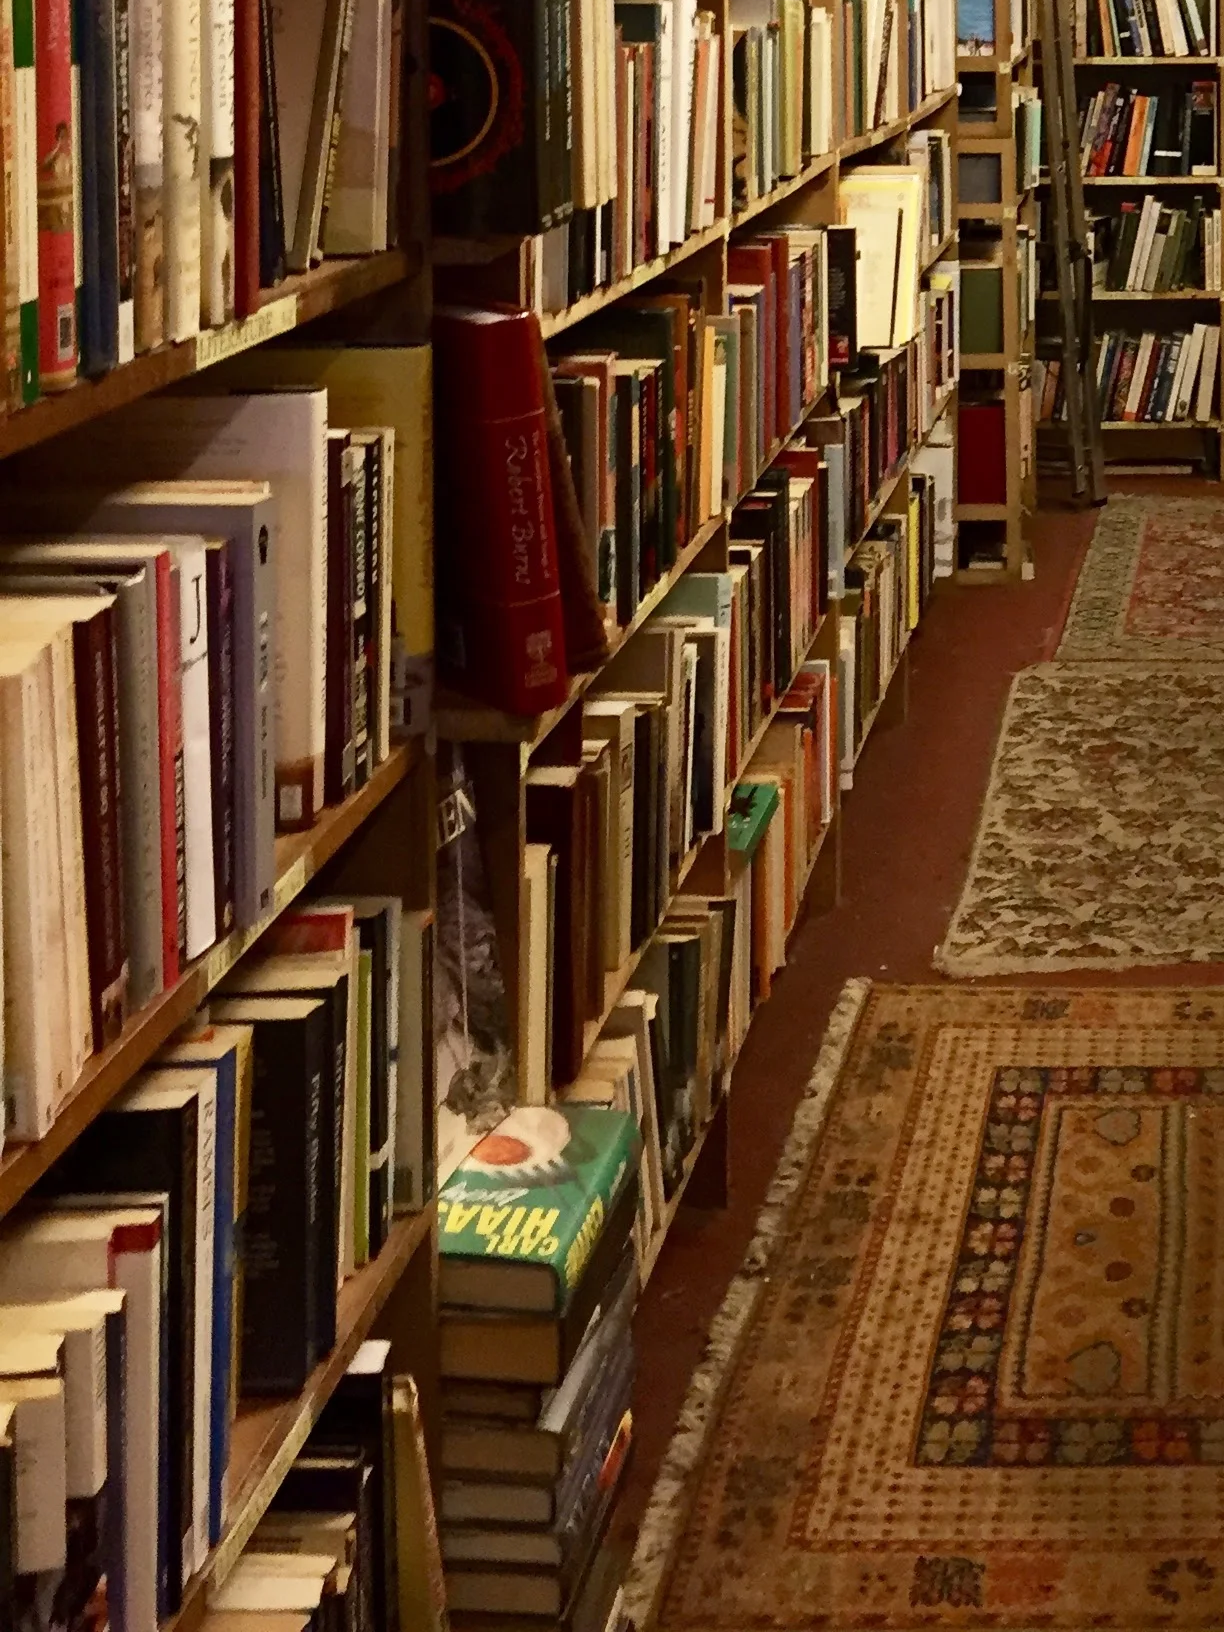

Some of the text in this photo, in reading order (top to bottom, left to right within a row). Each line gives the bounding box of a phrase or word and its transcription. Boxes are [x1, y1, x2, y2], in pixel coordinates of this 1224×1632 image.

[213, 23, 229, 108] person
[505, 435, 536, 585] Robert Burns
[188, 574, 204, 644] J
[437, 788, 477, 852] EN
[200, 1100, 216, 1242] RAMSES
[308, 1073, 321, 1224] Fifty Shades
[484, 1233, 560, 1256] CARL
